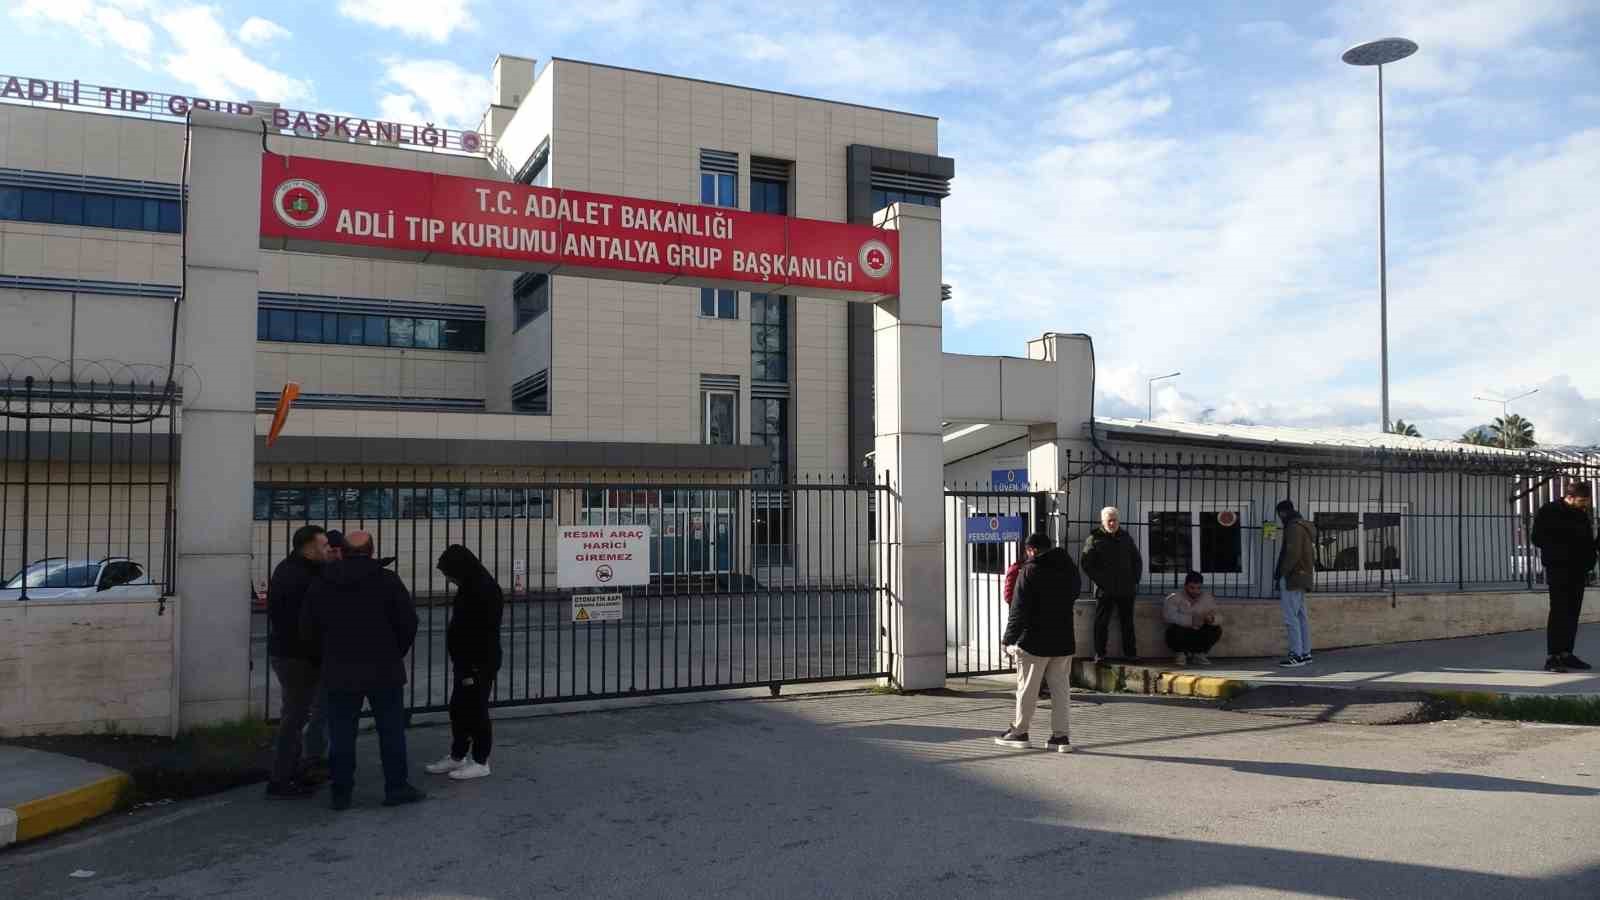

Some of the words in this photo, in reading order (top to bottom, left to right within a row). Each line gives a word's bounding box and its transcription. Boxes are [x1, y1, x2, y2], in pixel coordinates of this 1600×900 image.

[1, 76, 80, 104] ADLİ
[99, 86, 150, 111] TIP
[272, 108, 448, 148] BAŞKANLIĞI
[475, 188, 518, 215] T.C.
[525, 195, 614, 227] ADALET
[621, 205, 734, 240] BAKANLIĞI
[335, 208, 395, 239] ADLİ
[405, 215, 445, 243] TIP
[451, 222, 557, 255] KURUMU
[563, 233, 660, 265] ANTALYA
[667, 243, 722, 270] GRUP
[732, 250, 853, 283] BAŞKANLIĞI
[563, 529, 604, 539] RESMİ
[609, 530, 643, 540] ARAÇ
[583, 541, 626, 550] HARİCİ
[575, 553, 633, 561] GİREMEZ
